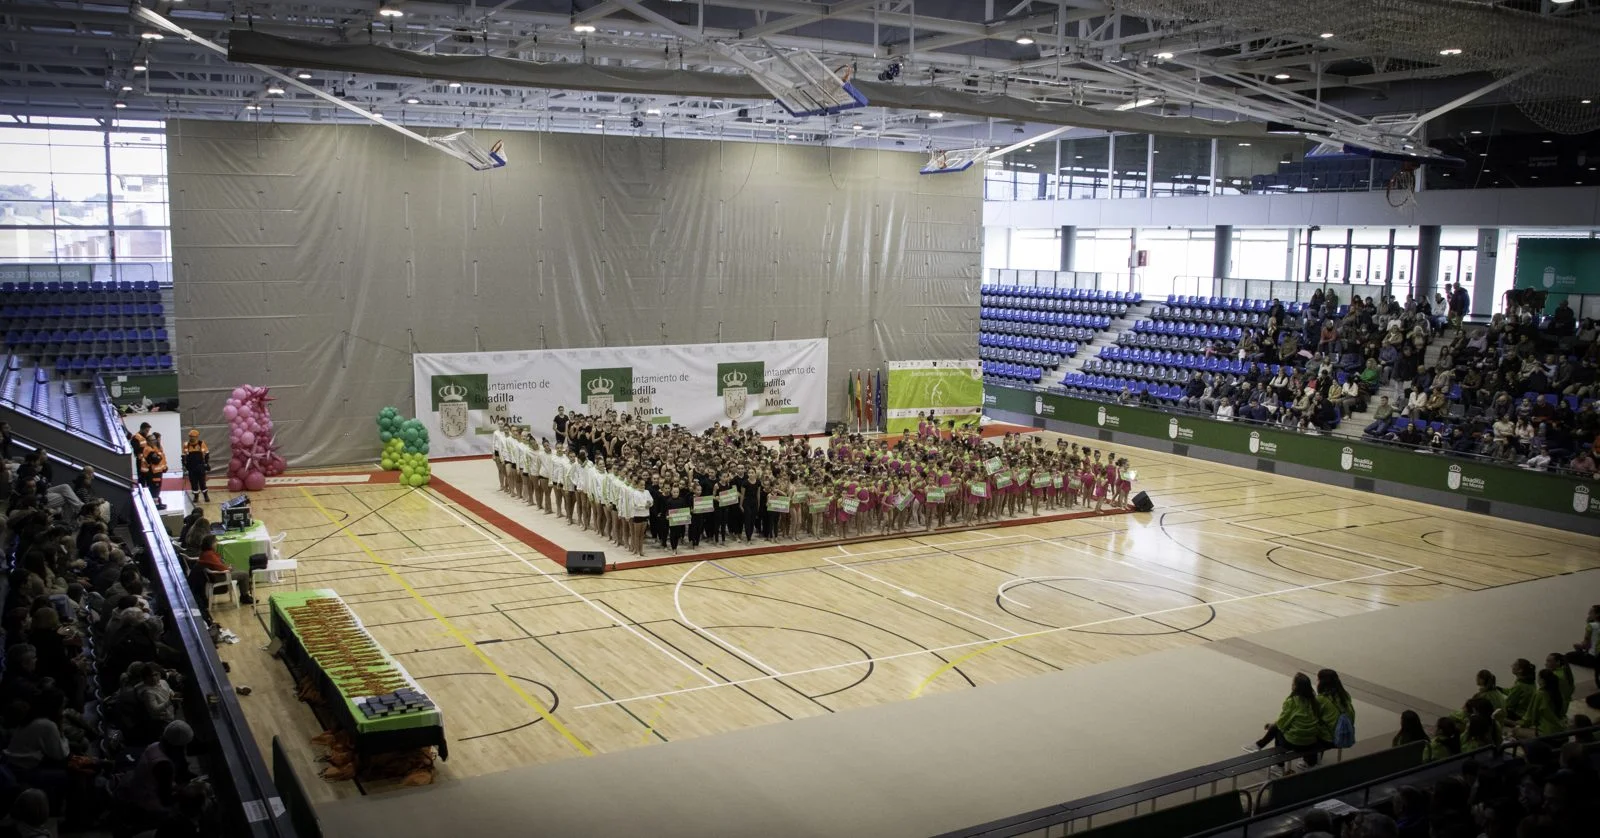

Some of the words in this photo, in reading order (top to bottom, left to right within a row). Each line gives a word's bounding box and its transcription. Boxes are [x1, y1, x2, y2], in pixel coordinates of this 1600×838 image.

[806, 366, 816, 374] de
[680, 373, 689, 382] de
[540, 379, 550, 388] de
[753, 379, 785, 388] Boadilla
[620, 386, 656, 396] Boadilla
[475, 393, 514, 404] Boadilla
[765, 398, 792, 407] Monte
[634, 406, 663, 415] Monte
[490, 415, 523, 424] Monte
[1462, 476, 1485, 484] Boadilla
